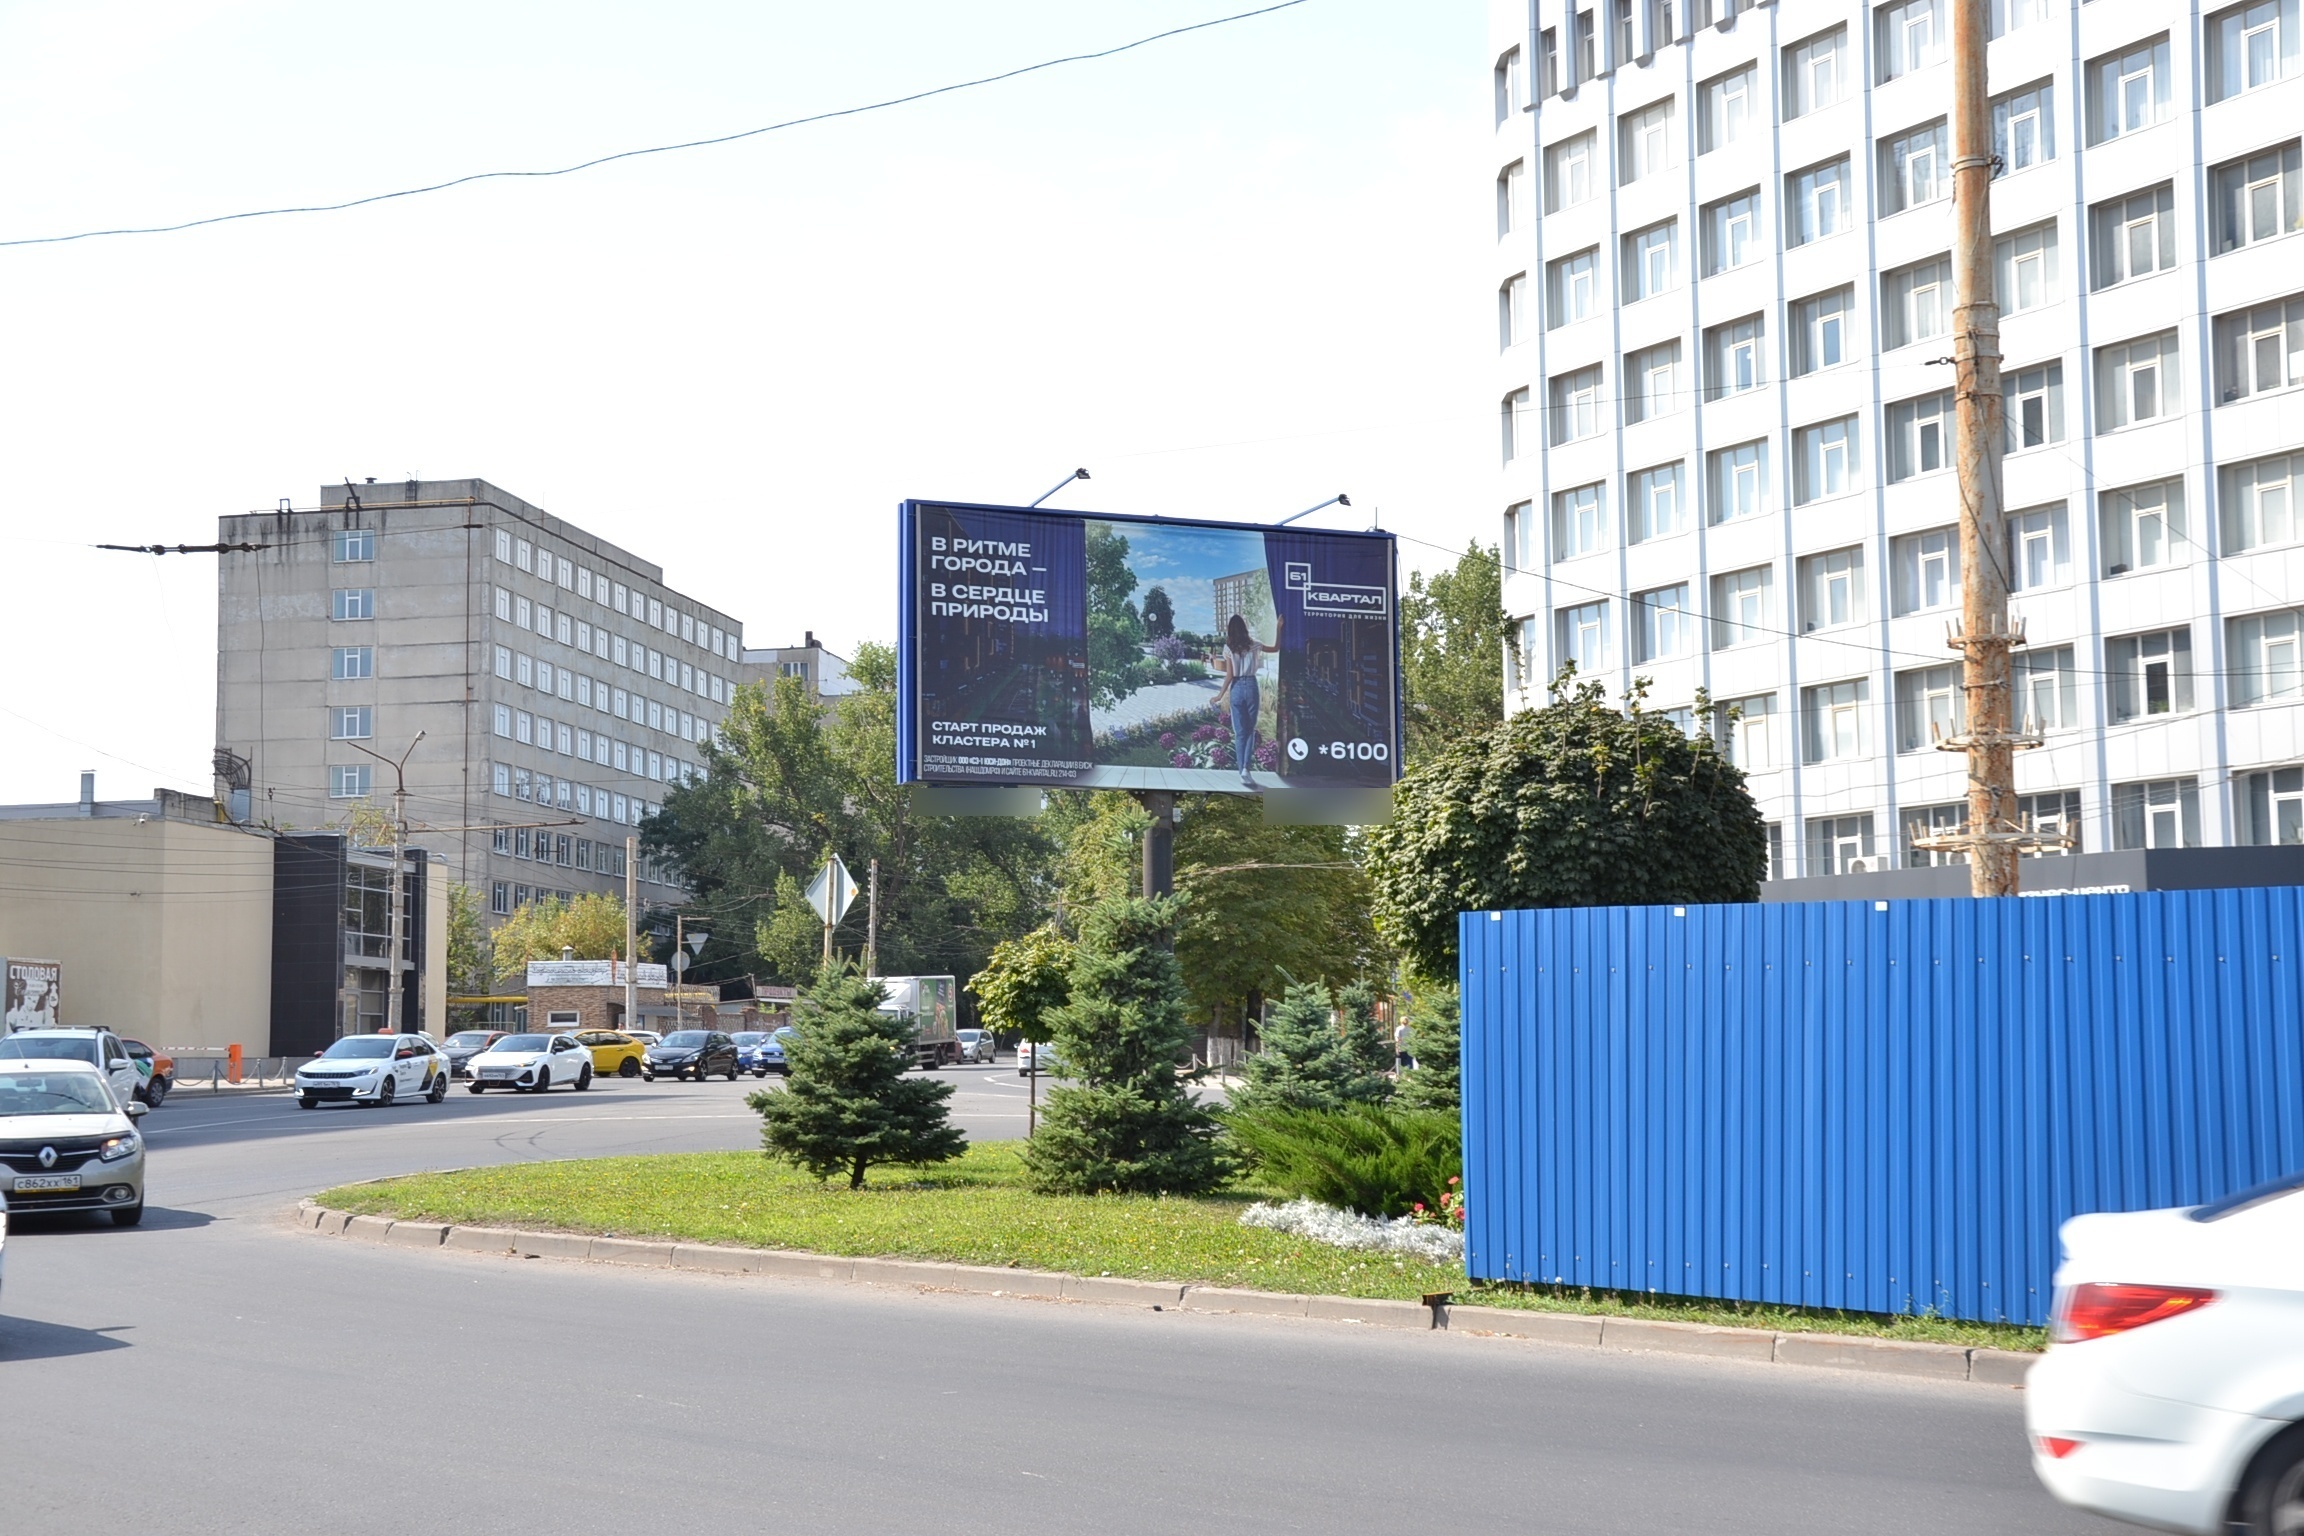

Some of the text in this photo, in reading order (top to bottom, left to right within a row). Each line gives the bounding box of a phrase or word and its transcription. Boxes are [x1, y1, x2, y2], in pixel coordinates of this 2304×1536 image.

[931, 536, 1031, 558] В РИТМЕ
[931, 555, 1027, 577] ГОРОДА
[1289, 571, 1307, 581] 61
[931, 582, 1046, 606] В СЕРДЦЕ
[1307, 591, 1382, 605] КВАРТАЛ
[931, 601, 1049, 624] ПРИРОДЫ
[1303, 611, 1346, 619] ТЕРРИТОРИЯ
[931, 721, 1047, 737] СТАРТ ПРОДАЖ
[932, 734, 1011, 748] КЛАСТЕРА
[10, 965, 58, 982] СТОЛОВАЯ
